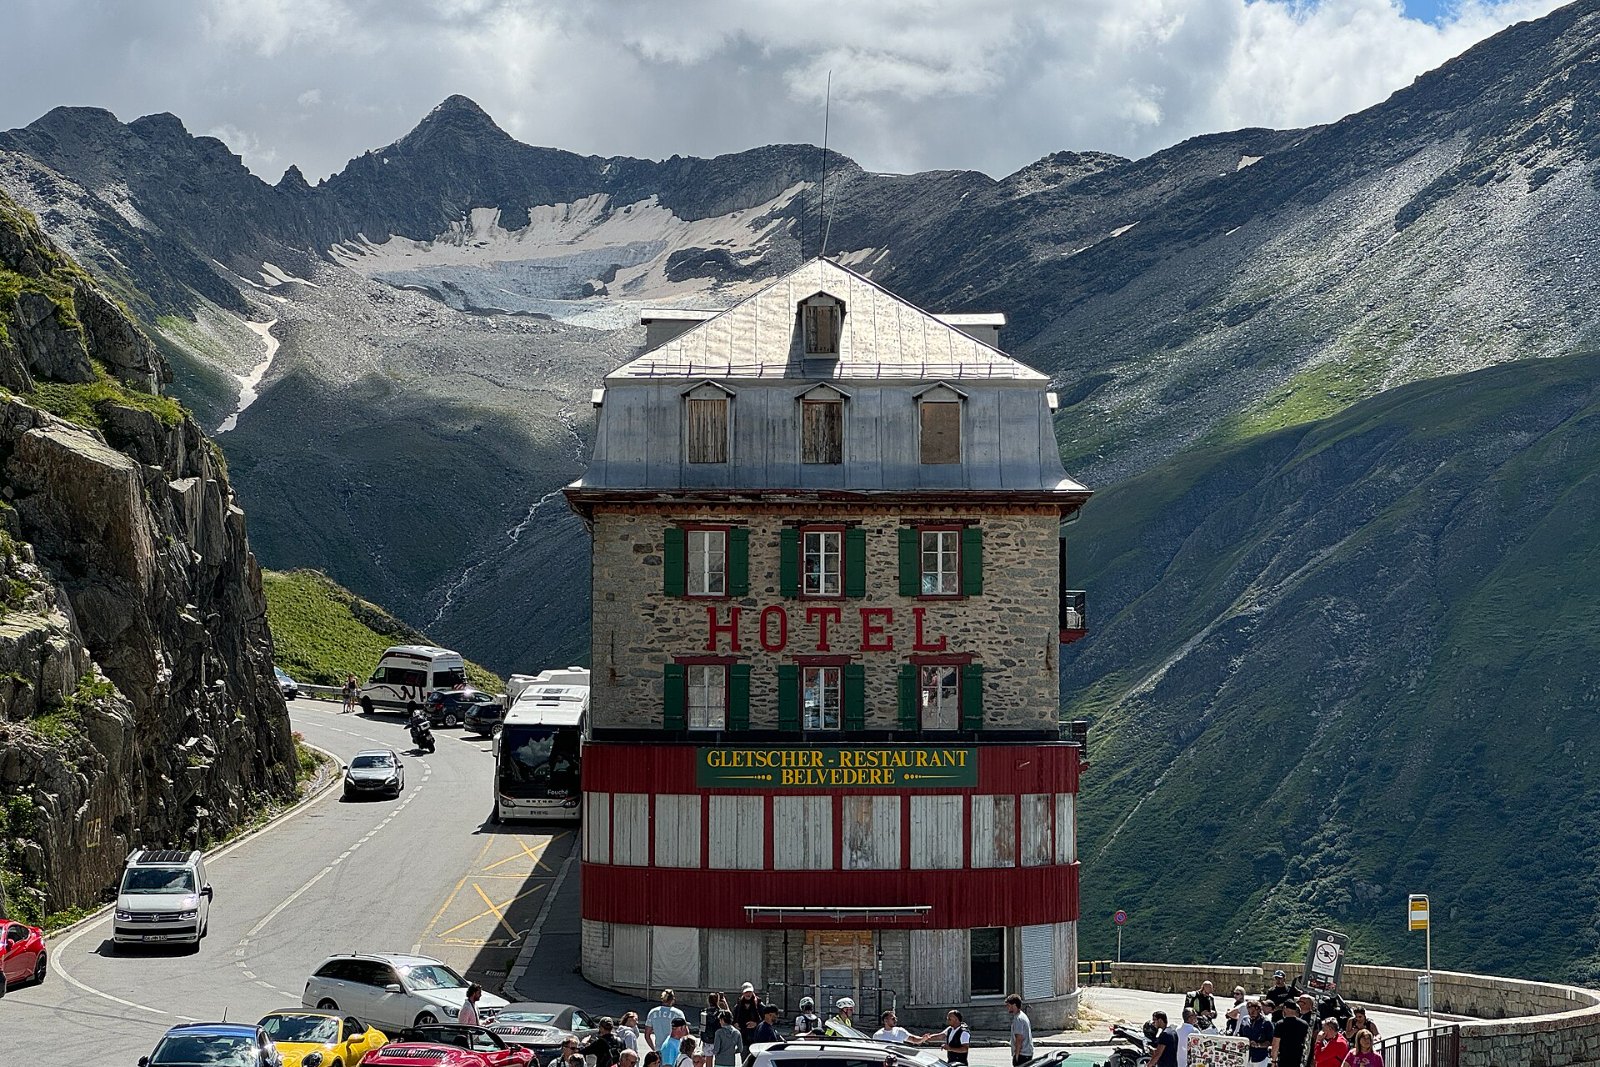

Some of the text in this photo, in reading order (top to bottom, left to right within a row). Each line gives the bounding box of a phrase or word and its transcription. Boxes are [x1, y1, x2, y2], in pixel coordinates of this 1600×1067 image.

[706, 605, 947, 652] HOTEL
[706, 750, 824, 768] GLETSCHER
[839, 750, 969, 767] RESTAURANT
[780, 768, 896, 786] BELVEDERE
